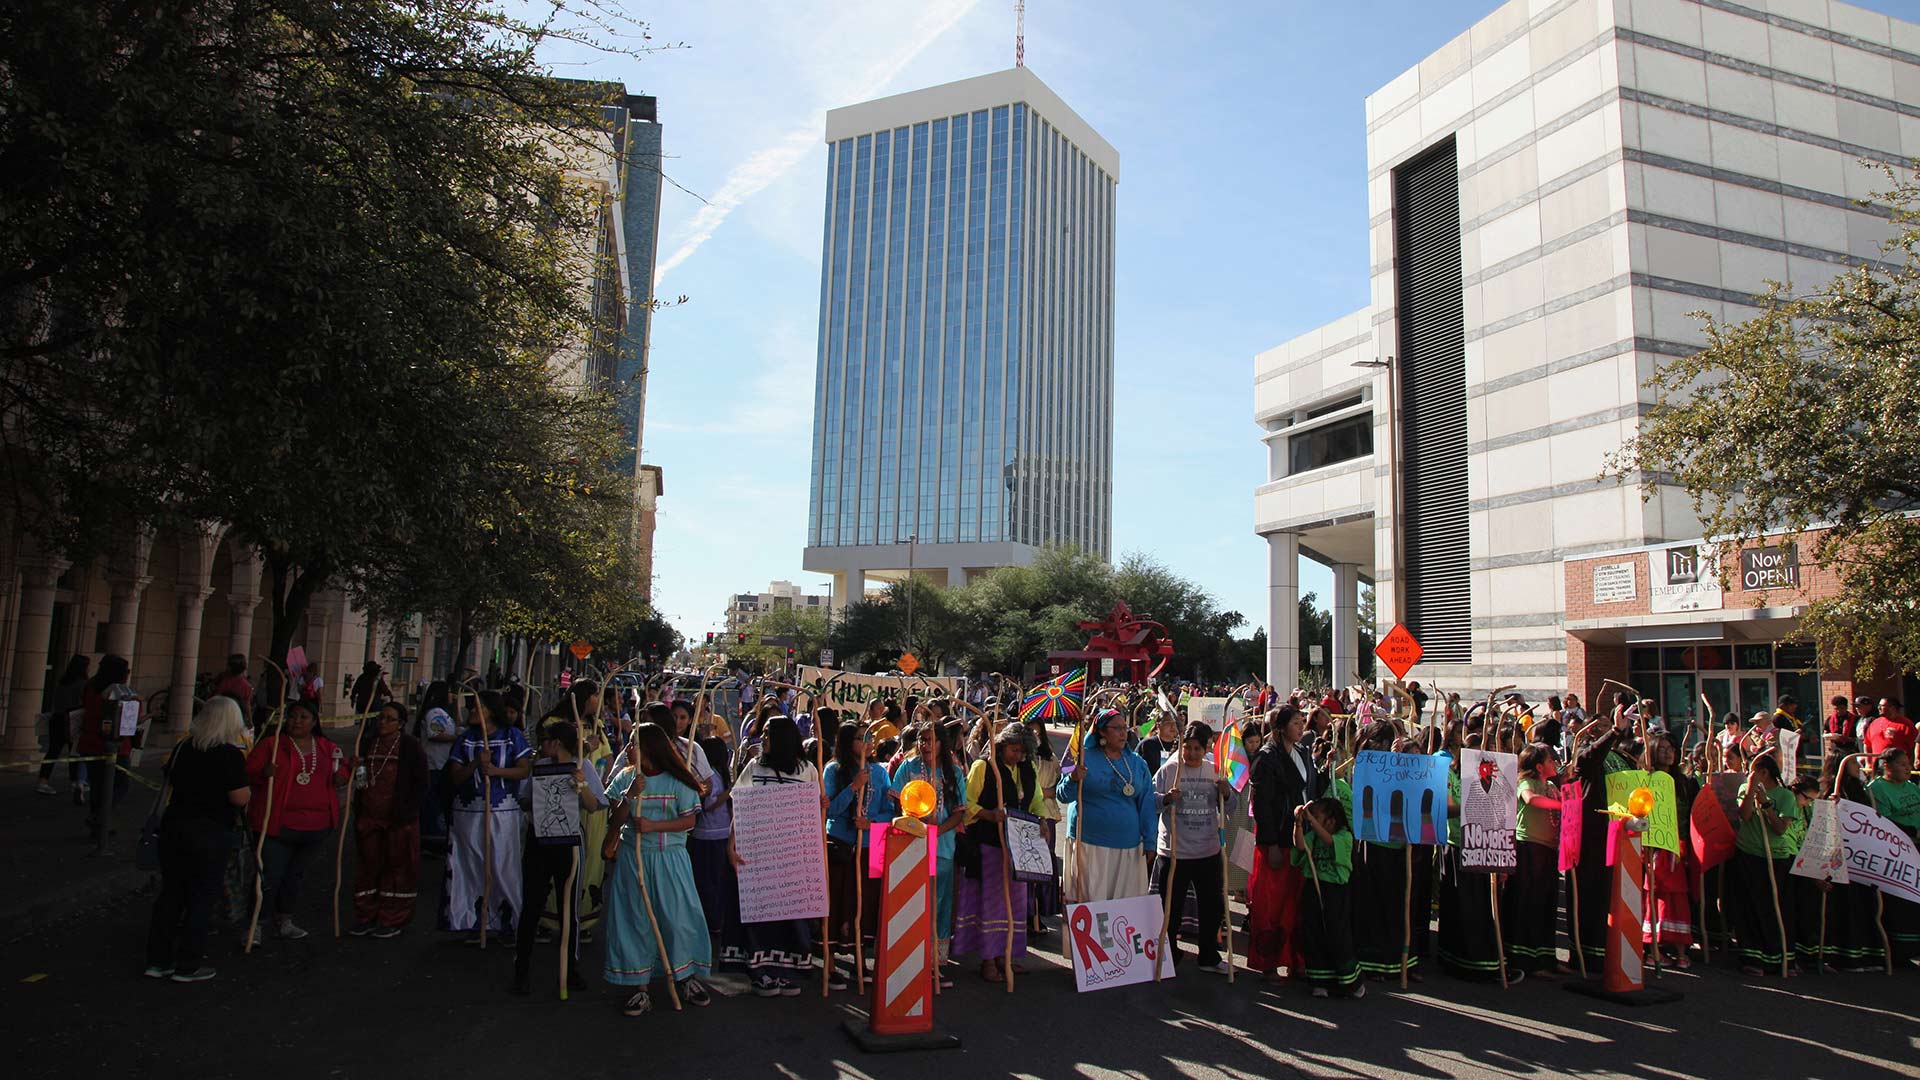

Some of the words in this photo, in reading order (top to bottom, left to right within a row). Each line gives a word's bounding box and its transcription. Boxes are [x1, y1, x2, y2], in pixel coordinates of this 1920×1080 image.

[1745, 567, 1793, 587] OPEN!
[1686, 581, 1721, 593] FITNESS
[1391, 636, 1410, 644] ROAD
[1390, 656, 1411, 664] AHEAD
[1743, 647, 1768, 666] 143
[775, 800, 798, 808] Women
[776, 815, 800, 823] Women
[773, 823, 800, 831] Women
[772, 830, 798, 838] Women
[1464, 824, 1482, 848] NO
[1482, 829, 1514, 849] MORE
[1842, 811, 1911, 858] Stronger
[775, 837, 802, 845] Women
[776, 844, 802, 853] Women
[776, 852, 802, 860] Women
[1487, 848, 1517, 867] SISTERS
[776, 861, 802, 869] Women
[778, 869, 804, 878] Women
[779, 879, 804, 888] Women
[780, 888, 807, 898] Women
[783, 898, 809, 907] Women
[782, 907, 806, 916] Women
